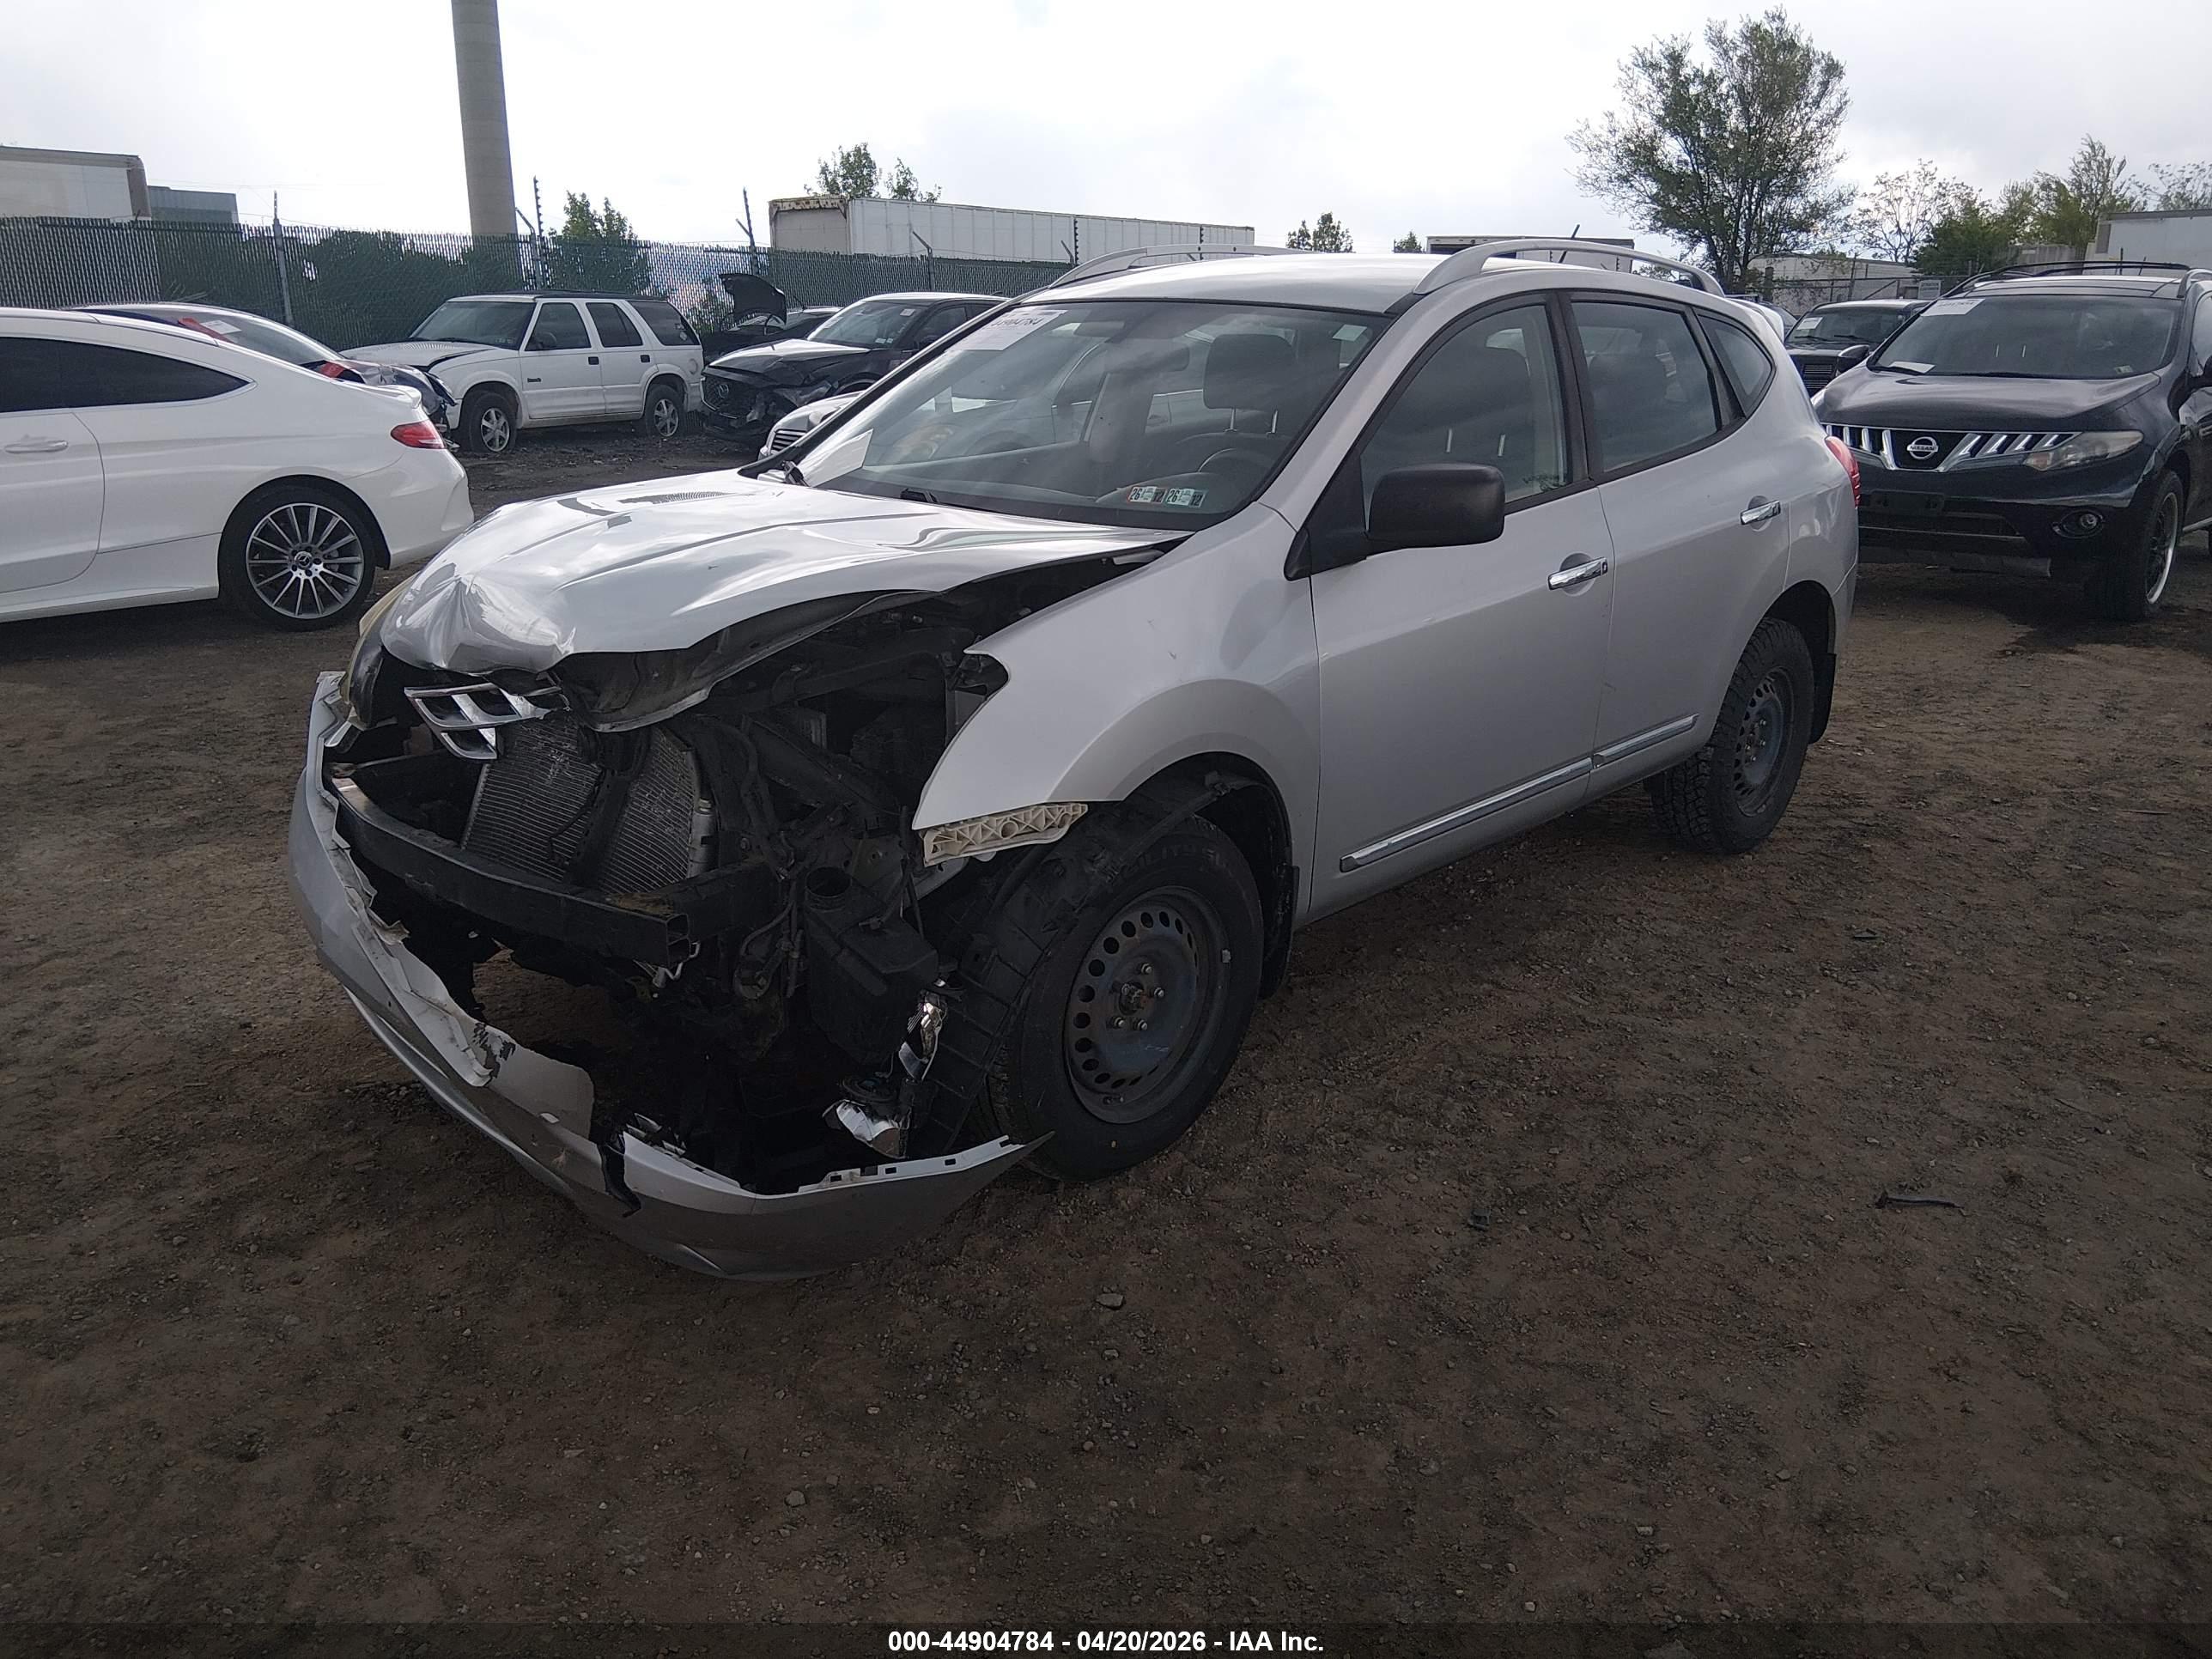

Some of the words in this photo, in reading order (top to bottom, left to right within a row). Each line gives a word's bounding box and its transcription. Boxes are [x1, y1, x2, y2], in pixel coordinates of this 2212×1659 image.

[1130, 488, 1143, 501] 26
[1167, 489, 1180, 502] 26
[1191, 494, 1203, 506] 12
